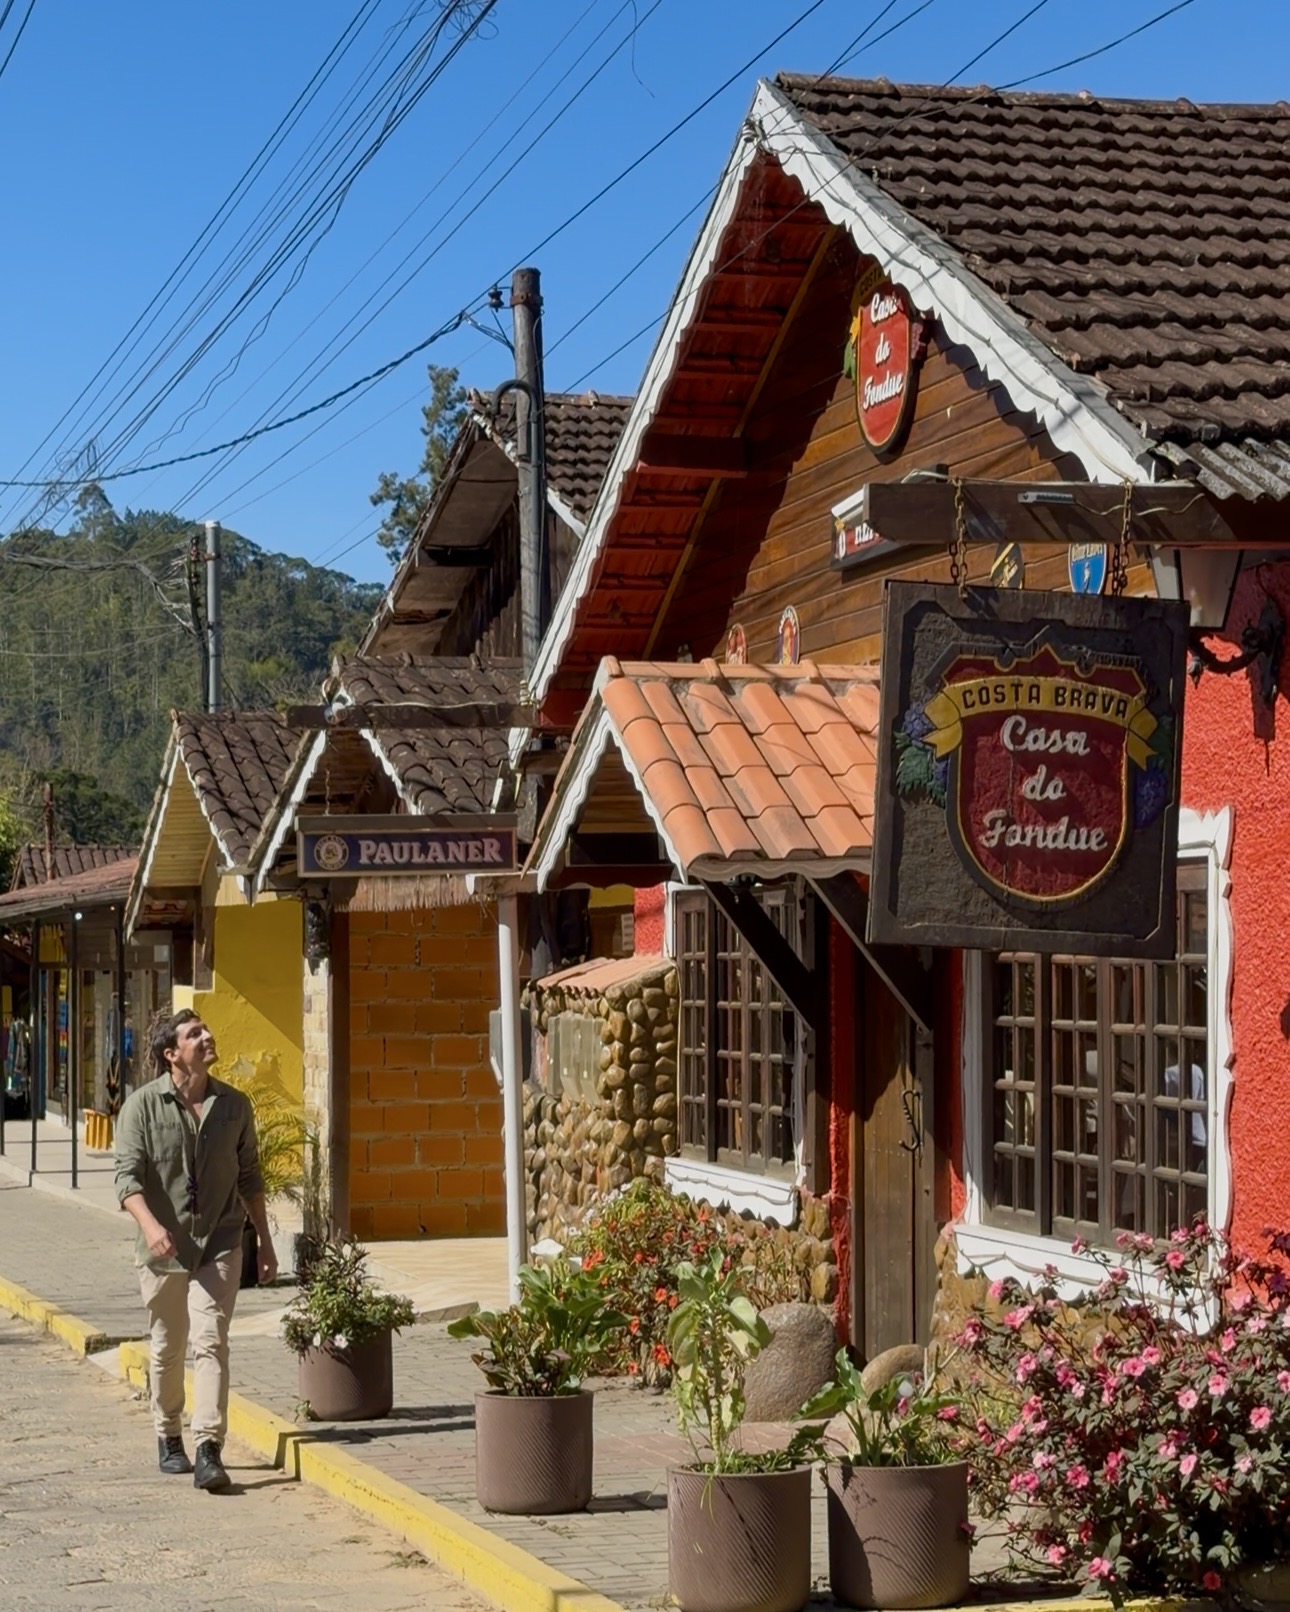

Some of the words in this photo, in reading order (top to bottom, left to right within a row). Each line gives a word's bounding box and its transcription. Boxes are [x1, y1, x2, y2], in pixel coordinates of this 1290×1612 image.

[962, 683, 1040, 709] COSTA
[1054, 686, 1128, 719] BRAVA
[1000, 715, 1090, 755] Casa
[980, 809, 1108, 851] Fondue
[358, 838, 504, 865] PAULANER
